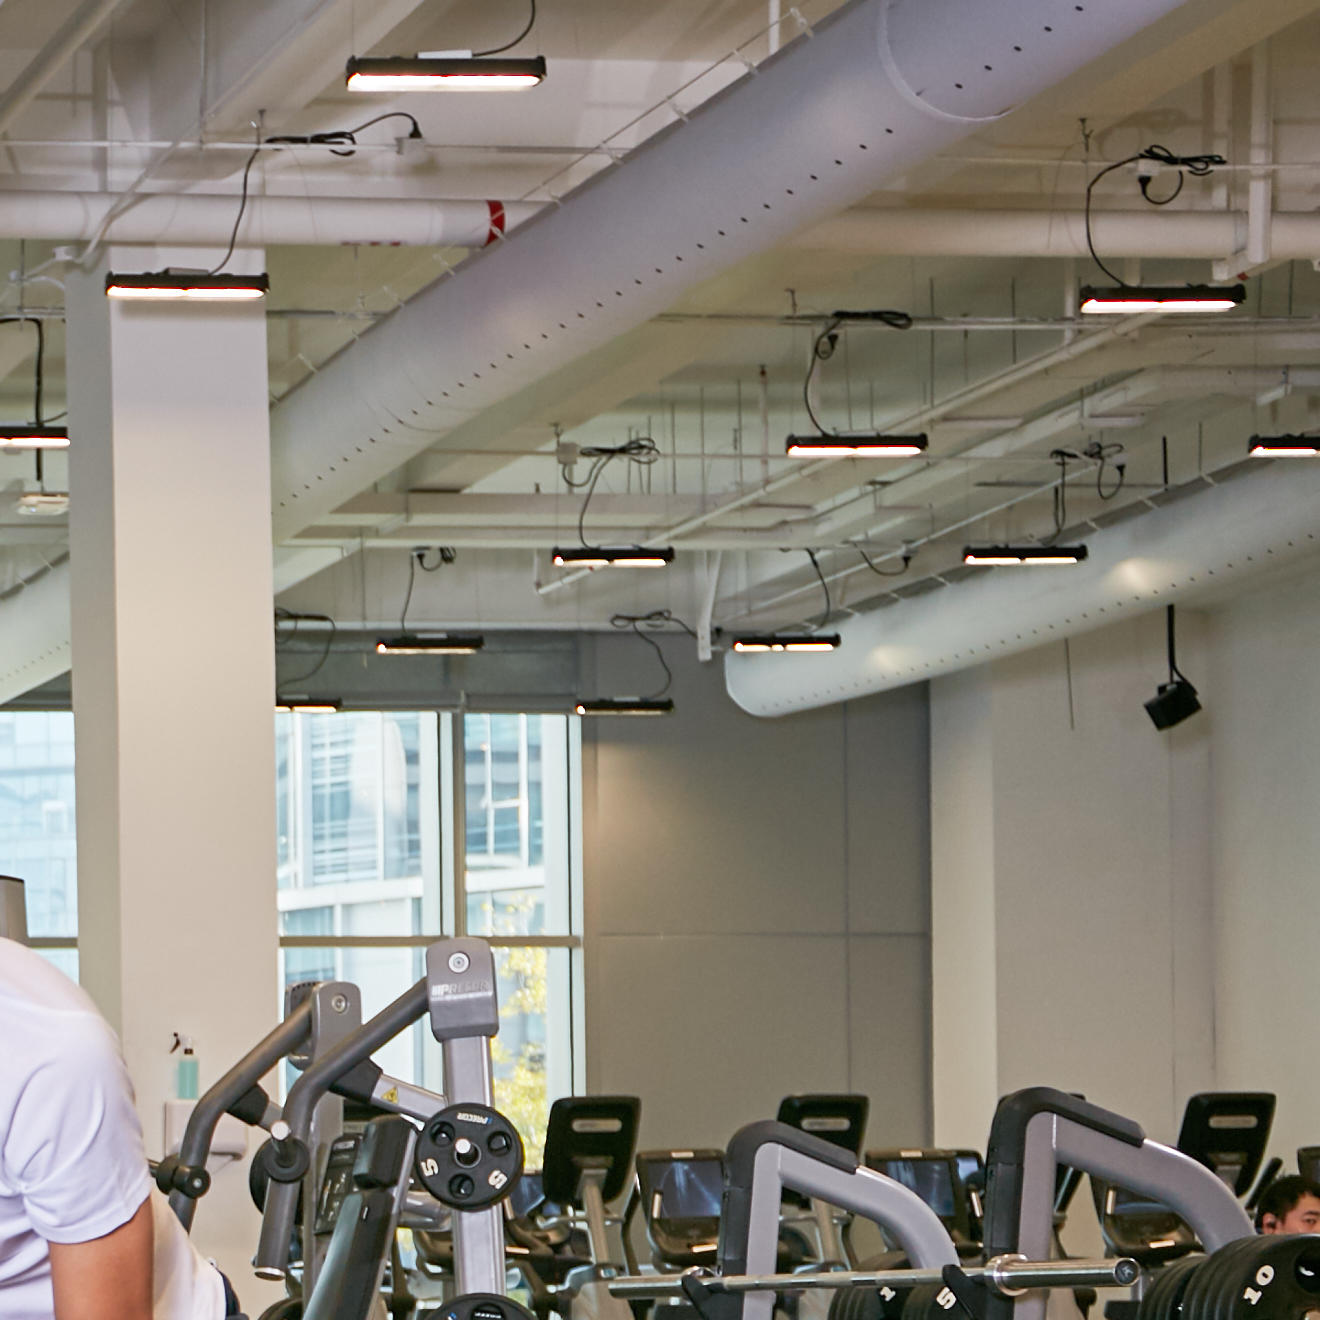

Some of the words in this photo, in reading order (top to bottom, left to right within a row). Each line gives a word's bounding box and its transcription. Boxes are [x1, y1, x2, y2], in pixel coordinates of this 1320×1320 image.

[457, 1112, 489, 1125] PRECOR
[421, 1158, 439, 1177] 5
[488, 1169, 508, 1190] 5
[1243, 1264, 1275, 1306] 10
